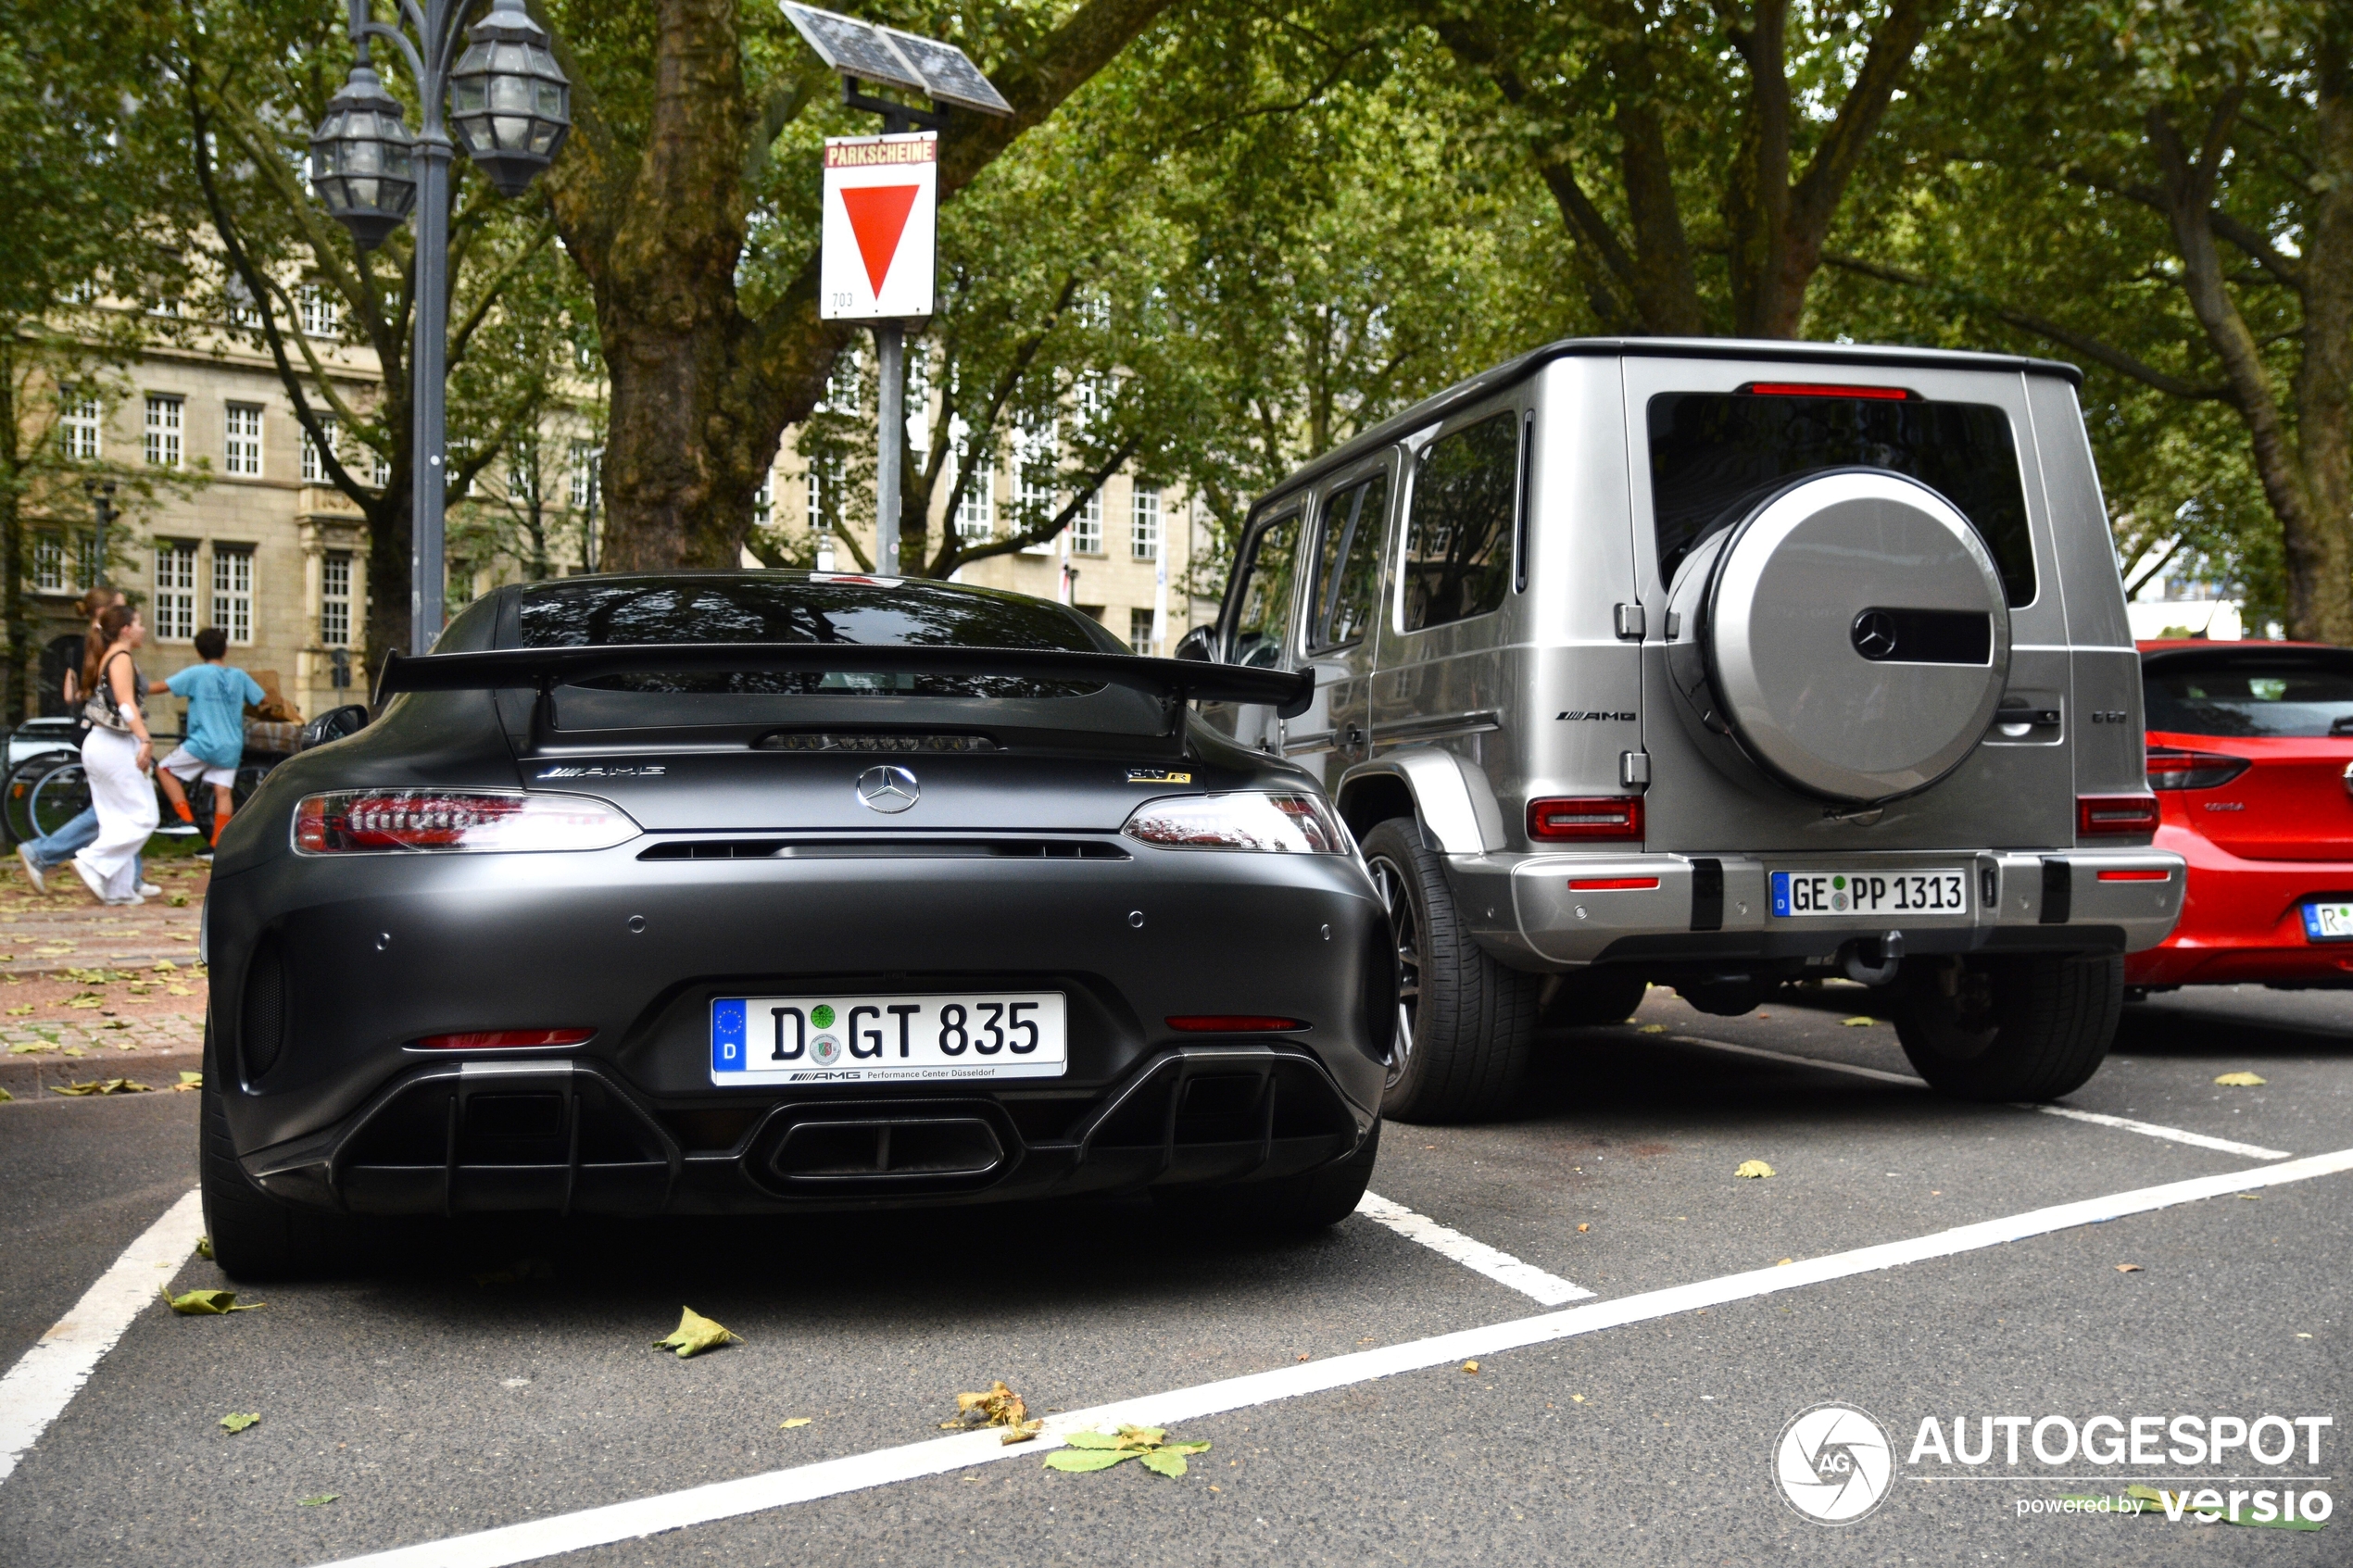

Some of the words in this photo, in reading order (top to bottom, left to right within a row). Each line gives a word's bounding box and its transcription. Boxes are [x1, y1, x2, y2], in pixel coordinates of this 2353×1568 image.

[828, 141, 933, 167] PARKSCHEINE
[832, 293, 853, 307] 703
[1582, 711, 1637, 721] AMG
[576, 766, 666, 777] AMG
[1793, 877, 1829, 910] GE
[1851, 876, 1886, 909] PP
[1894, 876, 1961, 909] 1313
[770, 1006, 806, 1060] D
[848, 1004, 921, 1059] GT
[938, 1001, 1039, 1057] 835
[724, 1043, 736, 1060] D
[812, 1071, 862, 1081] AMG
[867, 1070, 920, 1079] Performance
[922, 1069, 950, 1078] Center
[951, 1068, 996, 1077] Düsseldorf
